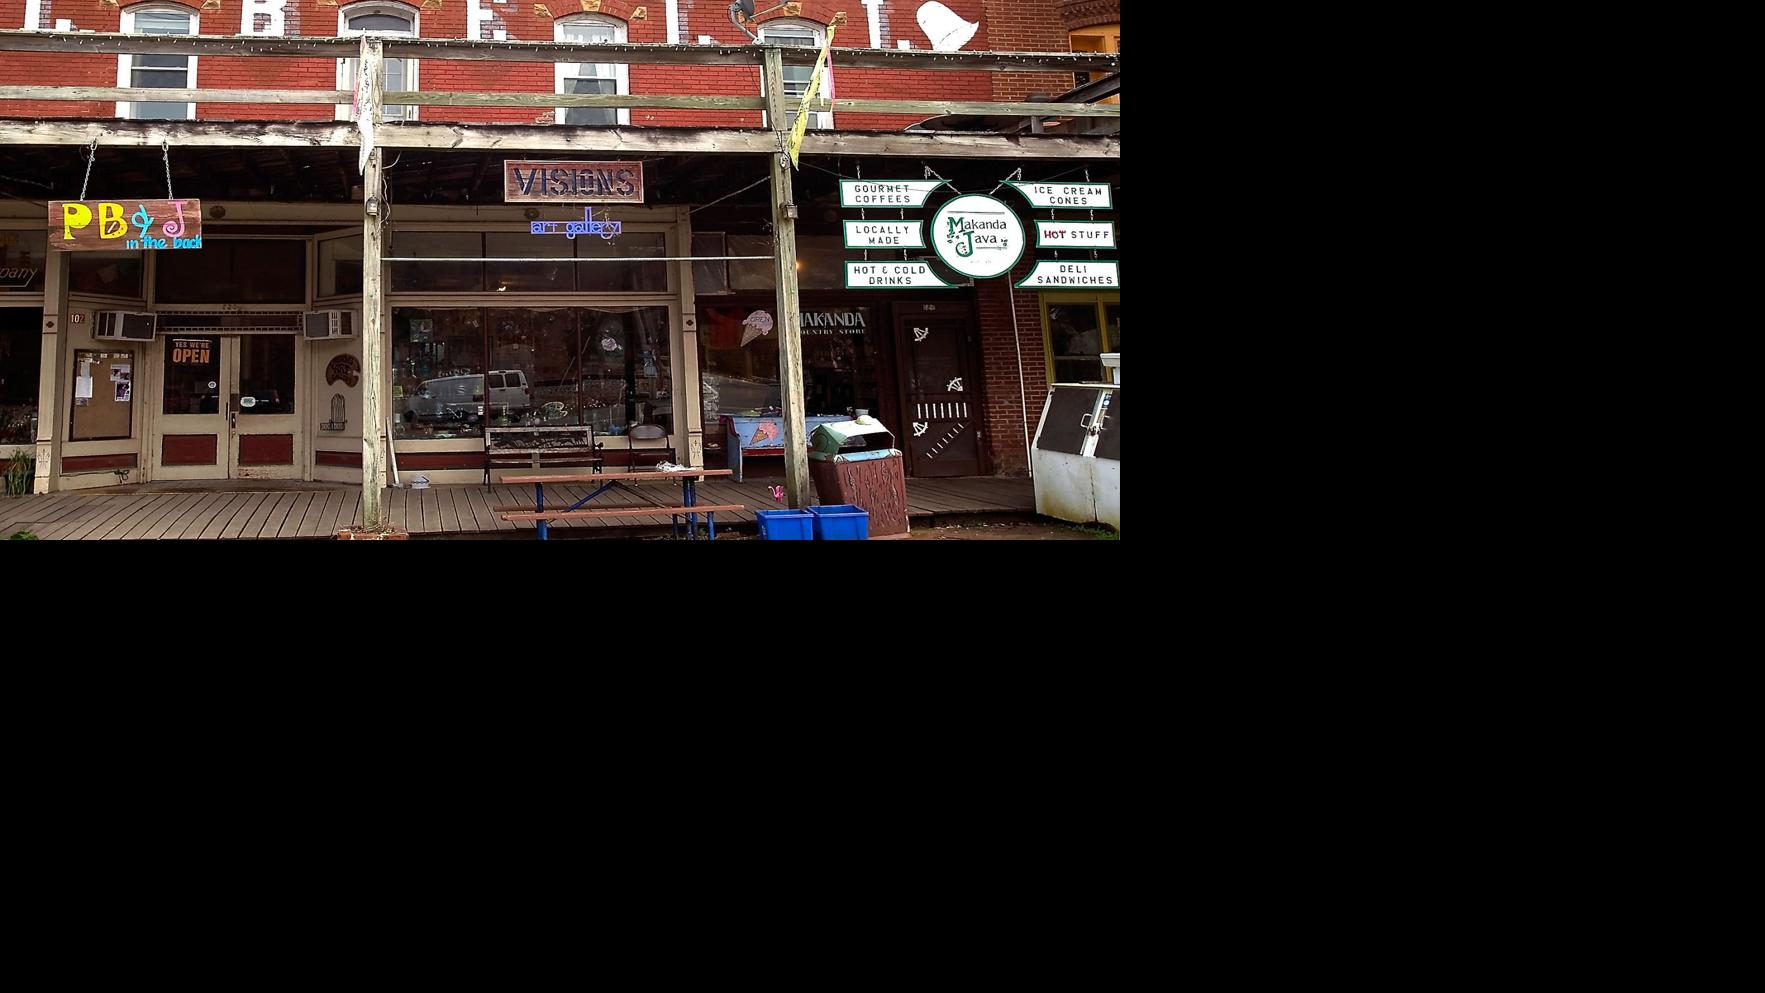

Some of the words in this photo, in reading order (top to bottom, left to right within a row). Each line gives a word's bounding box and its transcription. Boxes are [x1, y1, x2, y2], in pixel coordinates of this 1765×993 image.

[514, 167, 635, 196] VISIONS
[854, 184, 909, 193] GOURMET
[1034, 186, 1053, 195] ICE
[1063, 187, 1102, 196] CREAM
[855, 195, 910, 203] COFFEES
[1049, 196, 1087, 205] CONES
[162, 201, 186, 238] J
[531, 221, 558, 234] art
[565, 207, 621, 239] gallery
[855, 226, 909, 234] LOCALLY
[947, 216, 1007, 236] Makanda
[1044, 230, 1066, 239] HOT
[1071, 231, 1110, 239] STUFF
[126, 240, 139, 249] in
[140, 235, 168, 249] the
[173, 235, 202, 249] back
[868, 236, 900, 244] MADE
[955, 230, 998, 258] Java
[854, 266, 876, 274] HOT
[882, 266, 888, 274] &
[894, 266, 926, 274] COLD
[1060, 265, 1087, 274] DELI
[869, 276, 912, 285] DRINKS
[1037, 276, 1113, 285] SANDWICHES
[172, 348, 211, 363] OPEN
